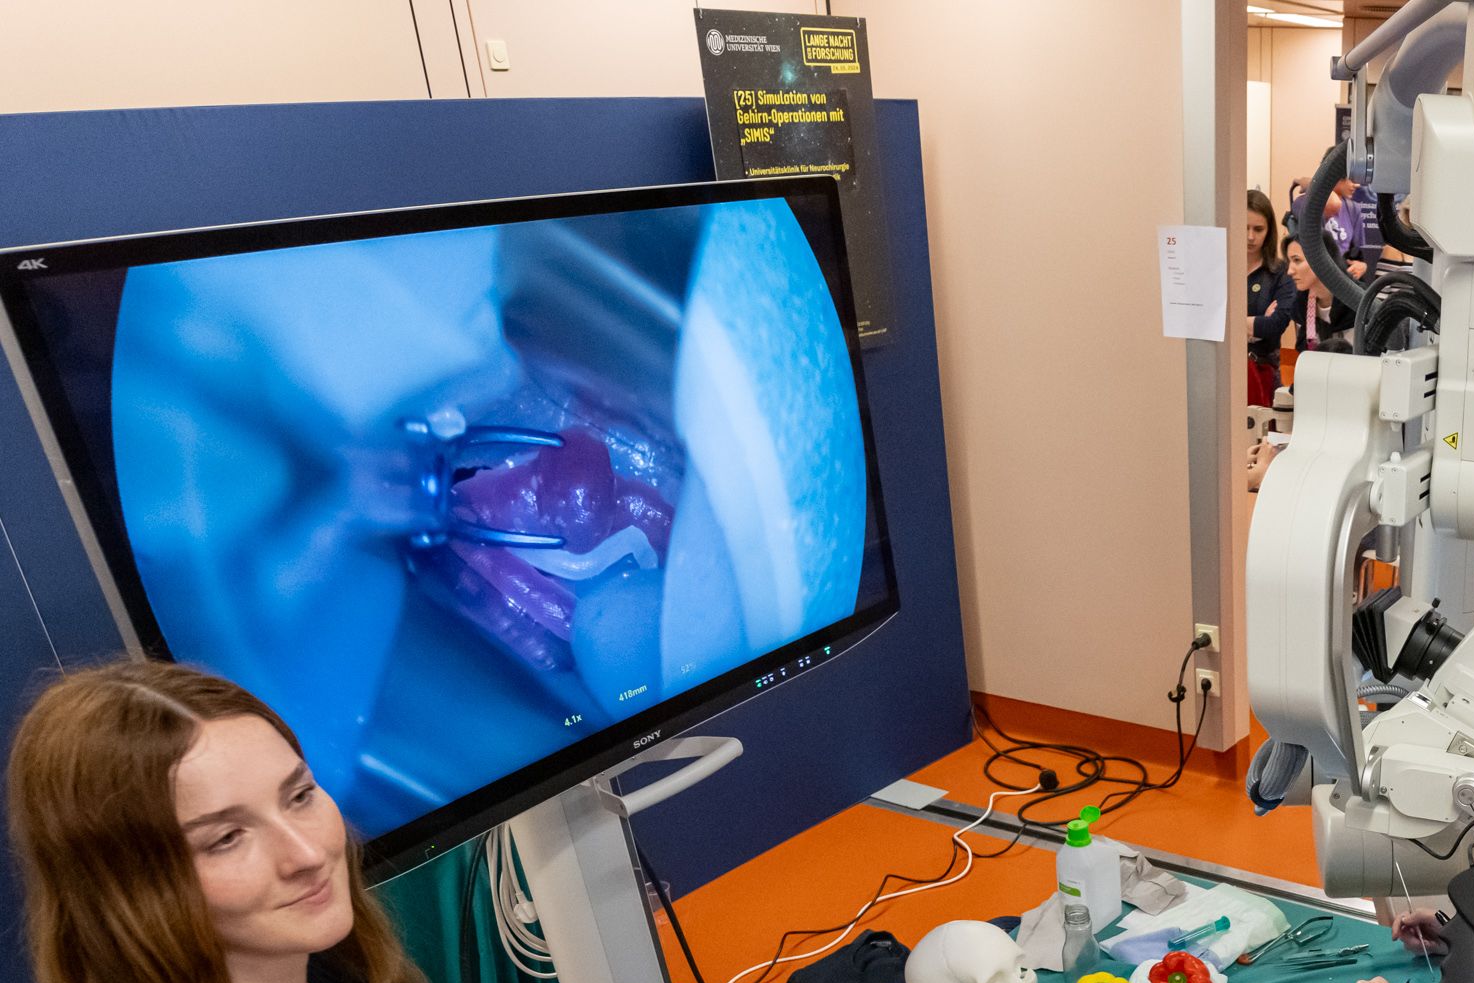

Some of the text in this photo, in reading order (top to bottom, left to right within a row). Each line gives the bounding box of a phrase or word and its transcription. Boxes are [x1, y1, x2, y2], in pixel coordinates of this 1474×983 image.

[725, 34, 767, 43] MEDIZINISCHE
[805, 34, 852, 47] LANGE NACHT
[726, 43, 780, 52] UNIVERSITÄT WIEN
[812, 48, 853, 60] FORSCHUNG
[734, 89, 827, 109] [25] Simulation von
[736, 108, 845, 127] Gehirn-Operationen mit
[810, 162, 849, 172] Neurochirurgie
[1167, 237, 1177, 246] 25
[17, 258, 48, 270] 4K
[619, 684, 648, 702] 418mm
[564, 715, 582, 727] 4.1x
[633, 730, 661, 749] SONY
